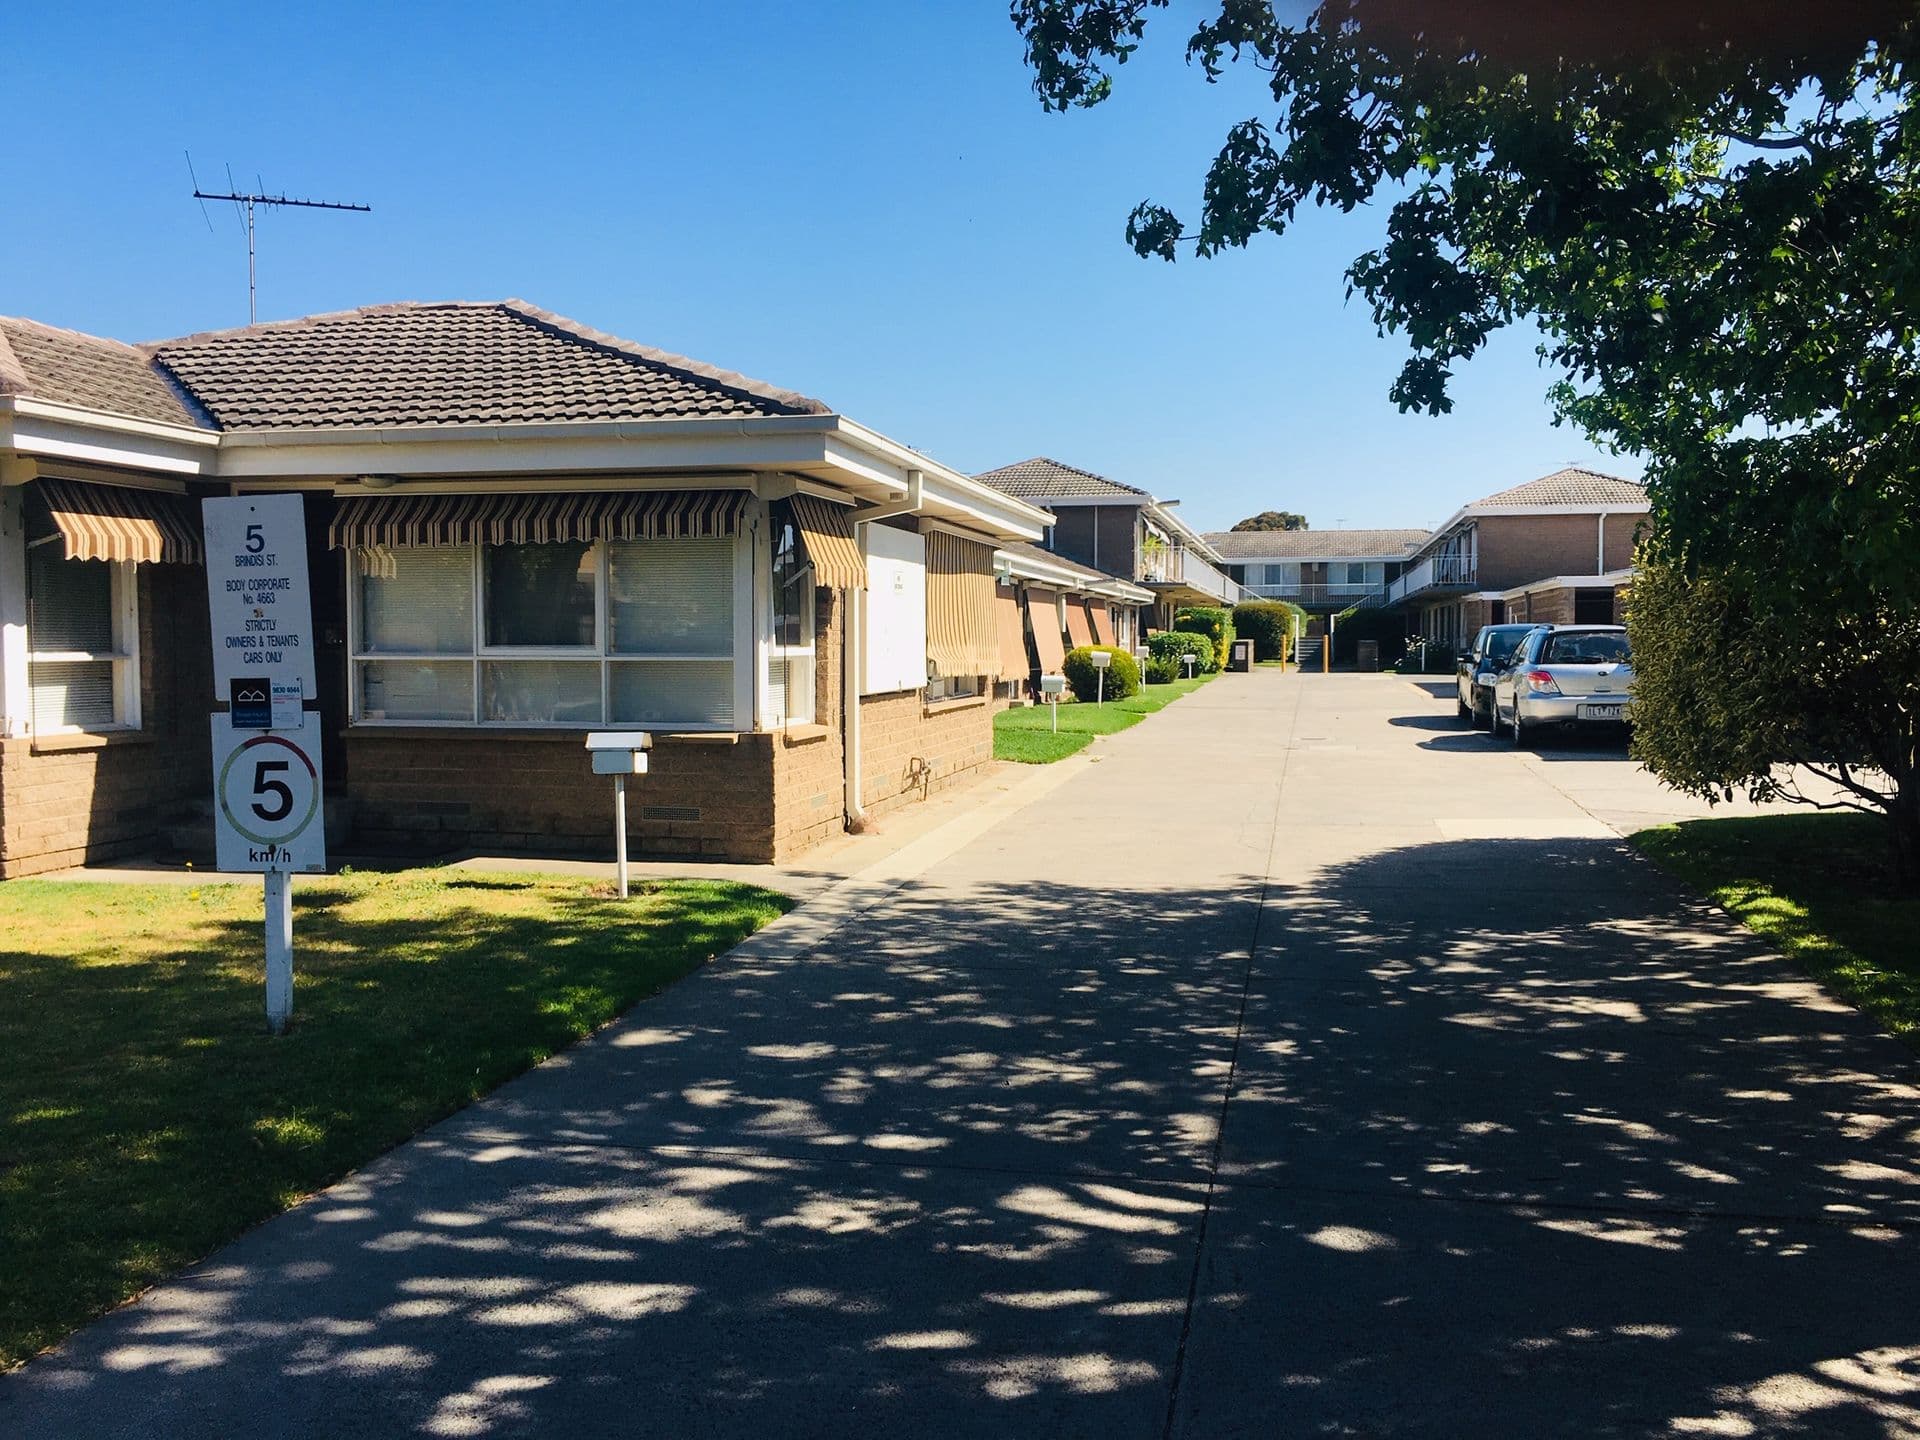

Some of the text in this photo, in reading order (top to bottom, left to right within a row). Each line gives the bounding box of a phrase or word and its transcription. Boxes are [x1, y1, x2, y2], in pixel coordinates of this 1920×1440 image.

[245, 525, 265, 553] 5
[234, 554, 279, 567] BRINDISI ST.
[226, 578, 290, 591] BODY CORPORATE
[242, 592, 275, 605] No. 4663
[245, 619, 277, 632] STRICTLY
[225, 634, 299, 648] OWNERS & TENANTS
[243, 651, 283, 664] CARS ONLY
[251, 761, 294, 821] 5
[249, 847, 292, 864] km/h
